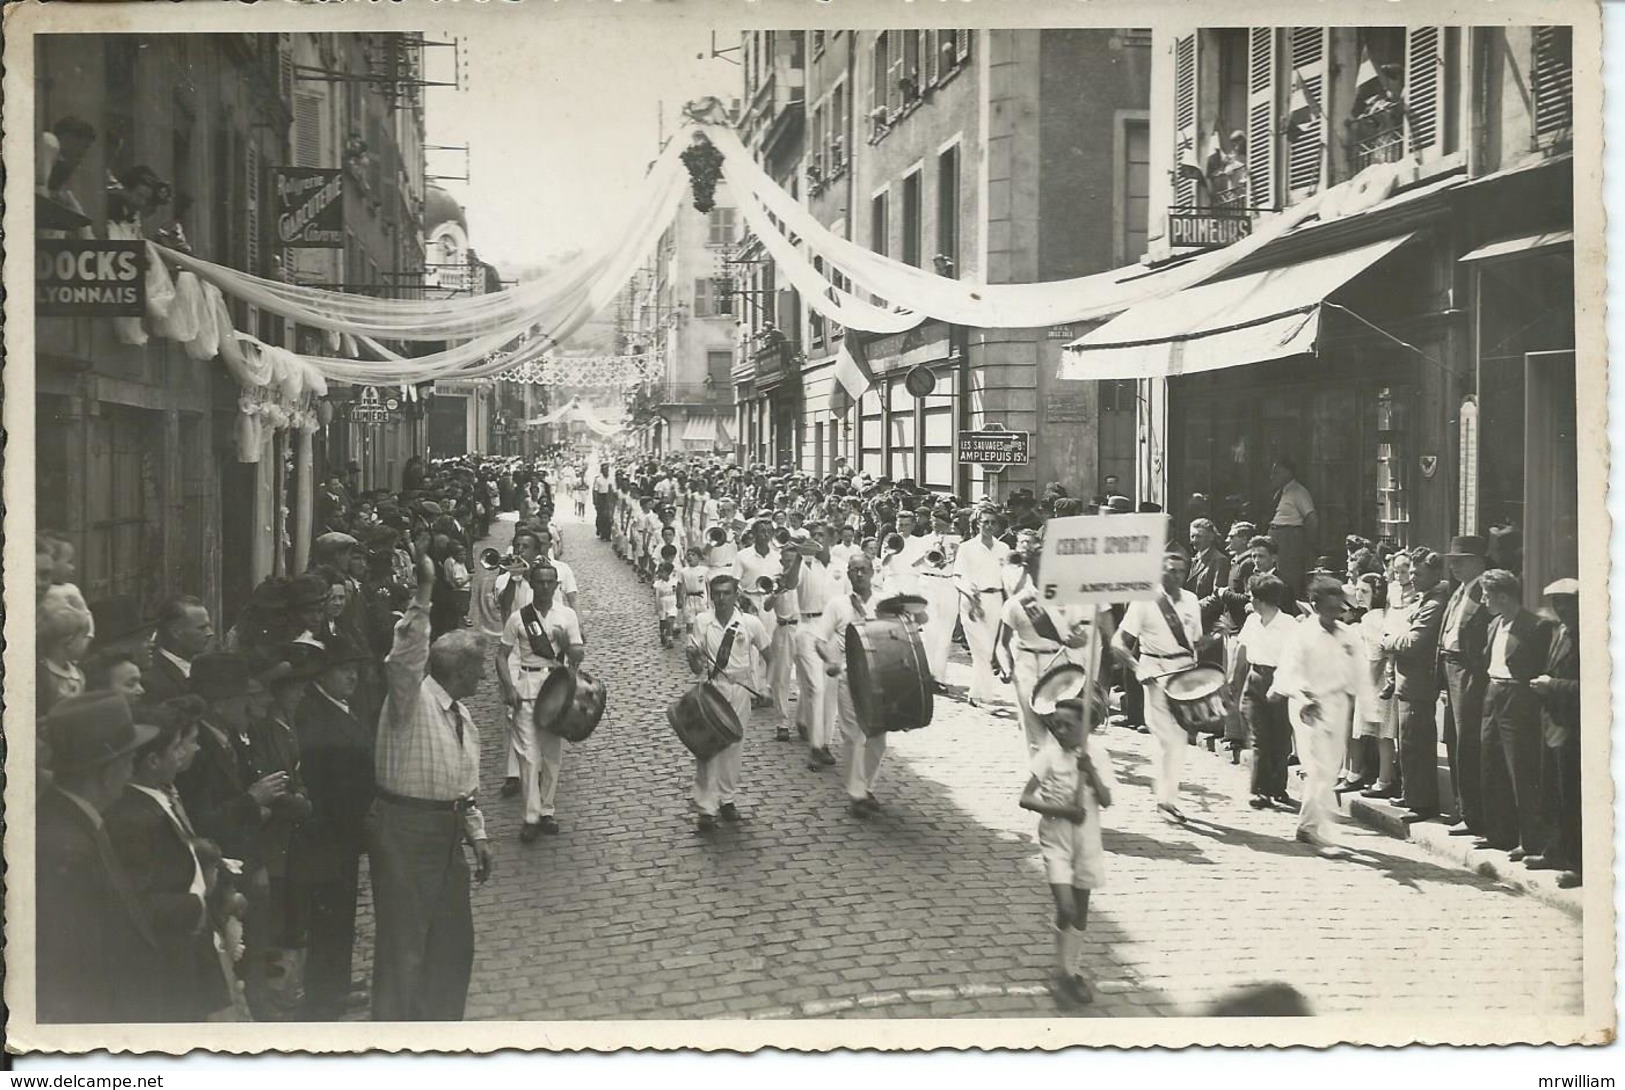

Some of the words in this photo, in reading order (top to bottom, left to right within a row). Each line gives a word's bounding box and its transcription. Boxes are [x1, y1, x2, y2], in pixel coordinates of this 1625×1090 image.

[1172, 218, 1249, 243] PRIMEURS
[36, 250, 138, 281] DOCKS
[37, 286, 137, 304] LYONNAIS
[960, 440, 971, 450] LES
[973, 440, 1004, 451] SAUVAGES
[960, 451, 1012, 462] AMPLEPUIS
[1056, 537, 1098, 555] CERCLE
[1044, 584, 1058, 600] 5
[1079, 582, 1154, 593] AMPLEPUIS
